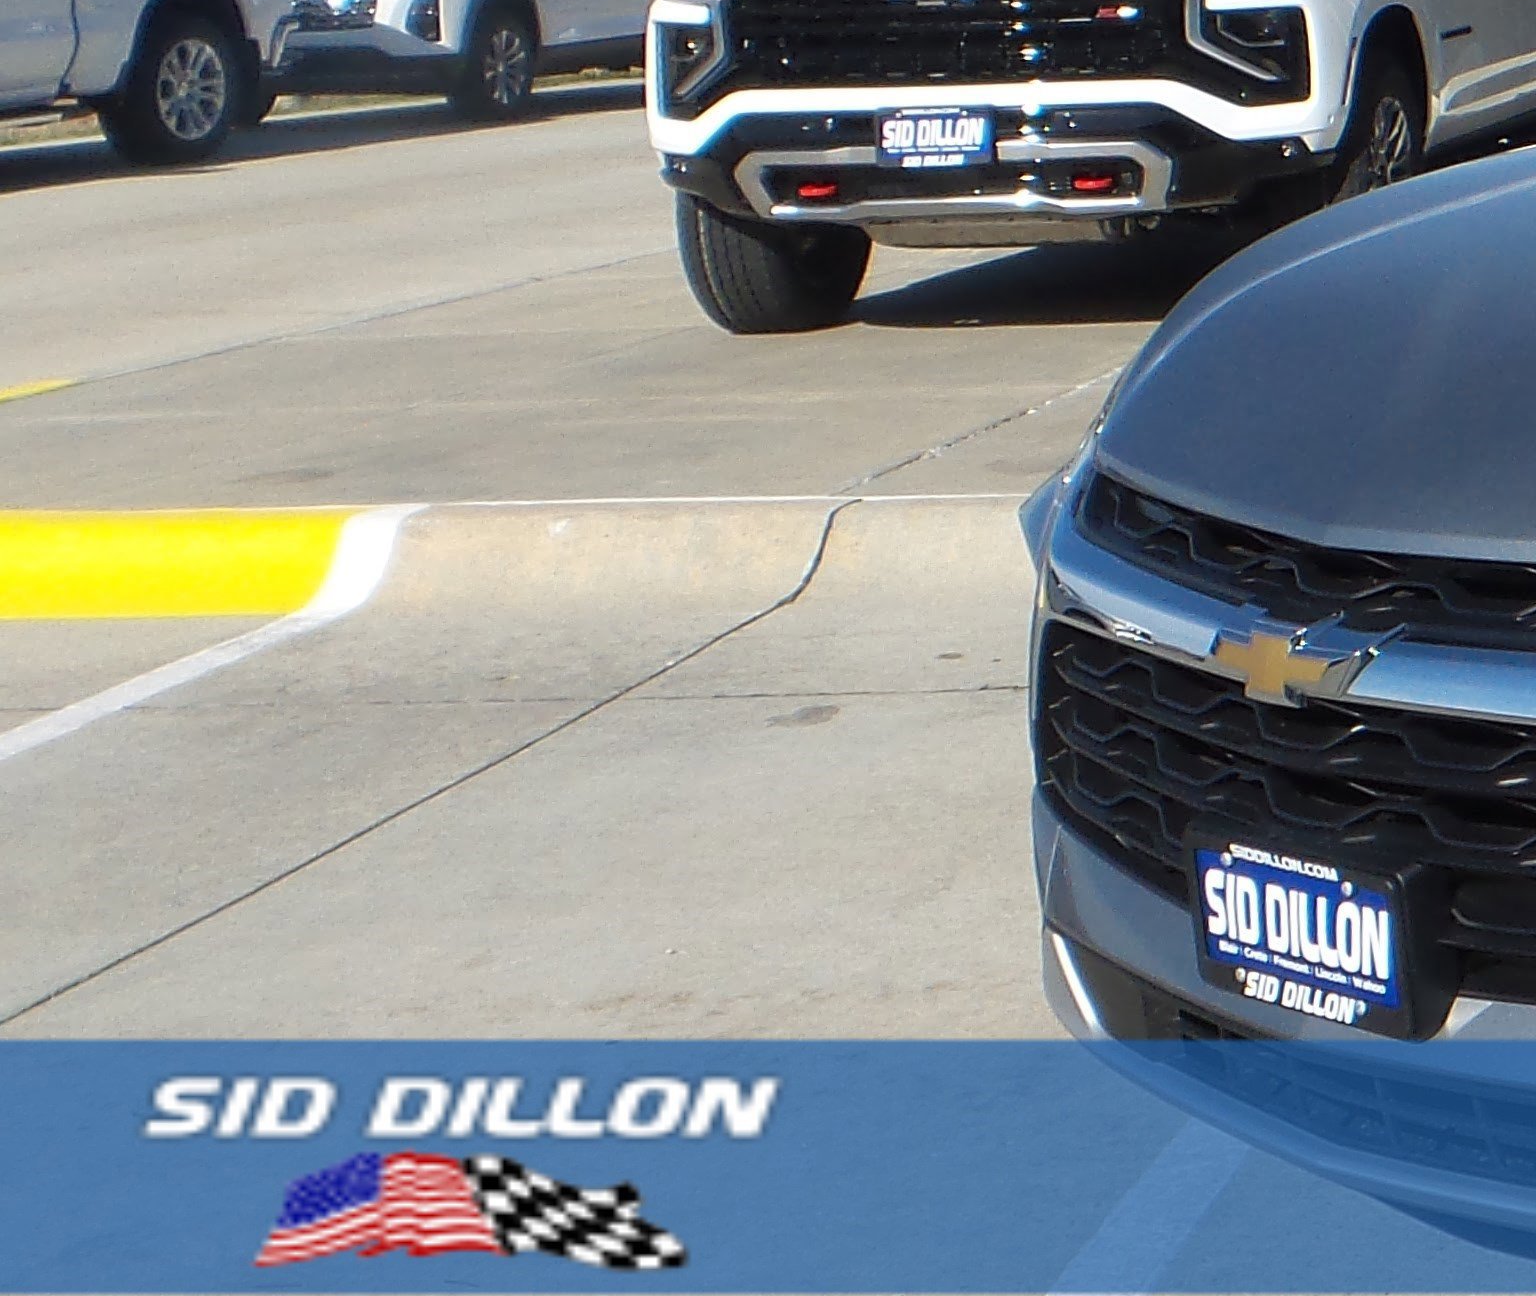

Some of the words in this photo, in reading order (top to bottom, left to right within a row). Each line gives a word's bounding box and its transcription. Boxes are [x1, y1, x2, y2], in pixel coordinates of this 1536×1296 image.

[881, 118, 915, 149] SID
[915, 116, 985, 148] DILLON
[1228, 842, 1339, 883] SIDDILLON.COM
[1203, 867, 1261, 946] SID
[1264, 882, 1390, 981] DILLON
[1243, 970, 1280, 1004] SID
[1280, 980, 1358, 1025] DILLON
